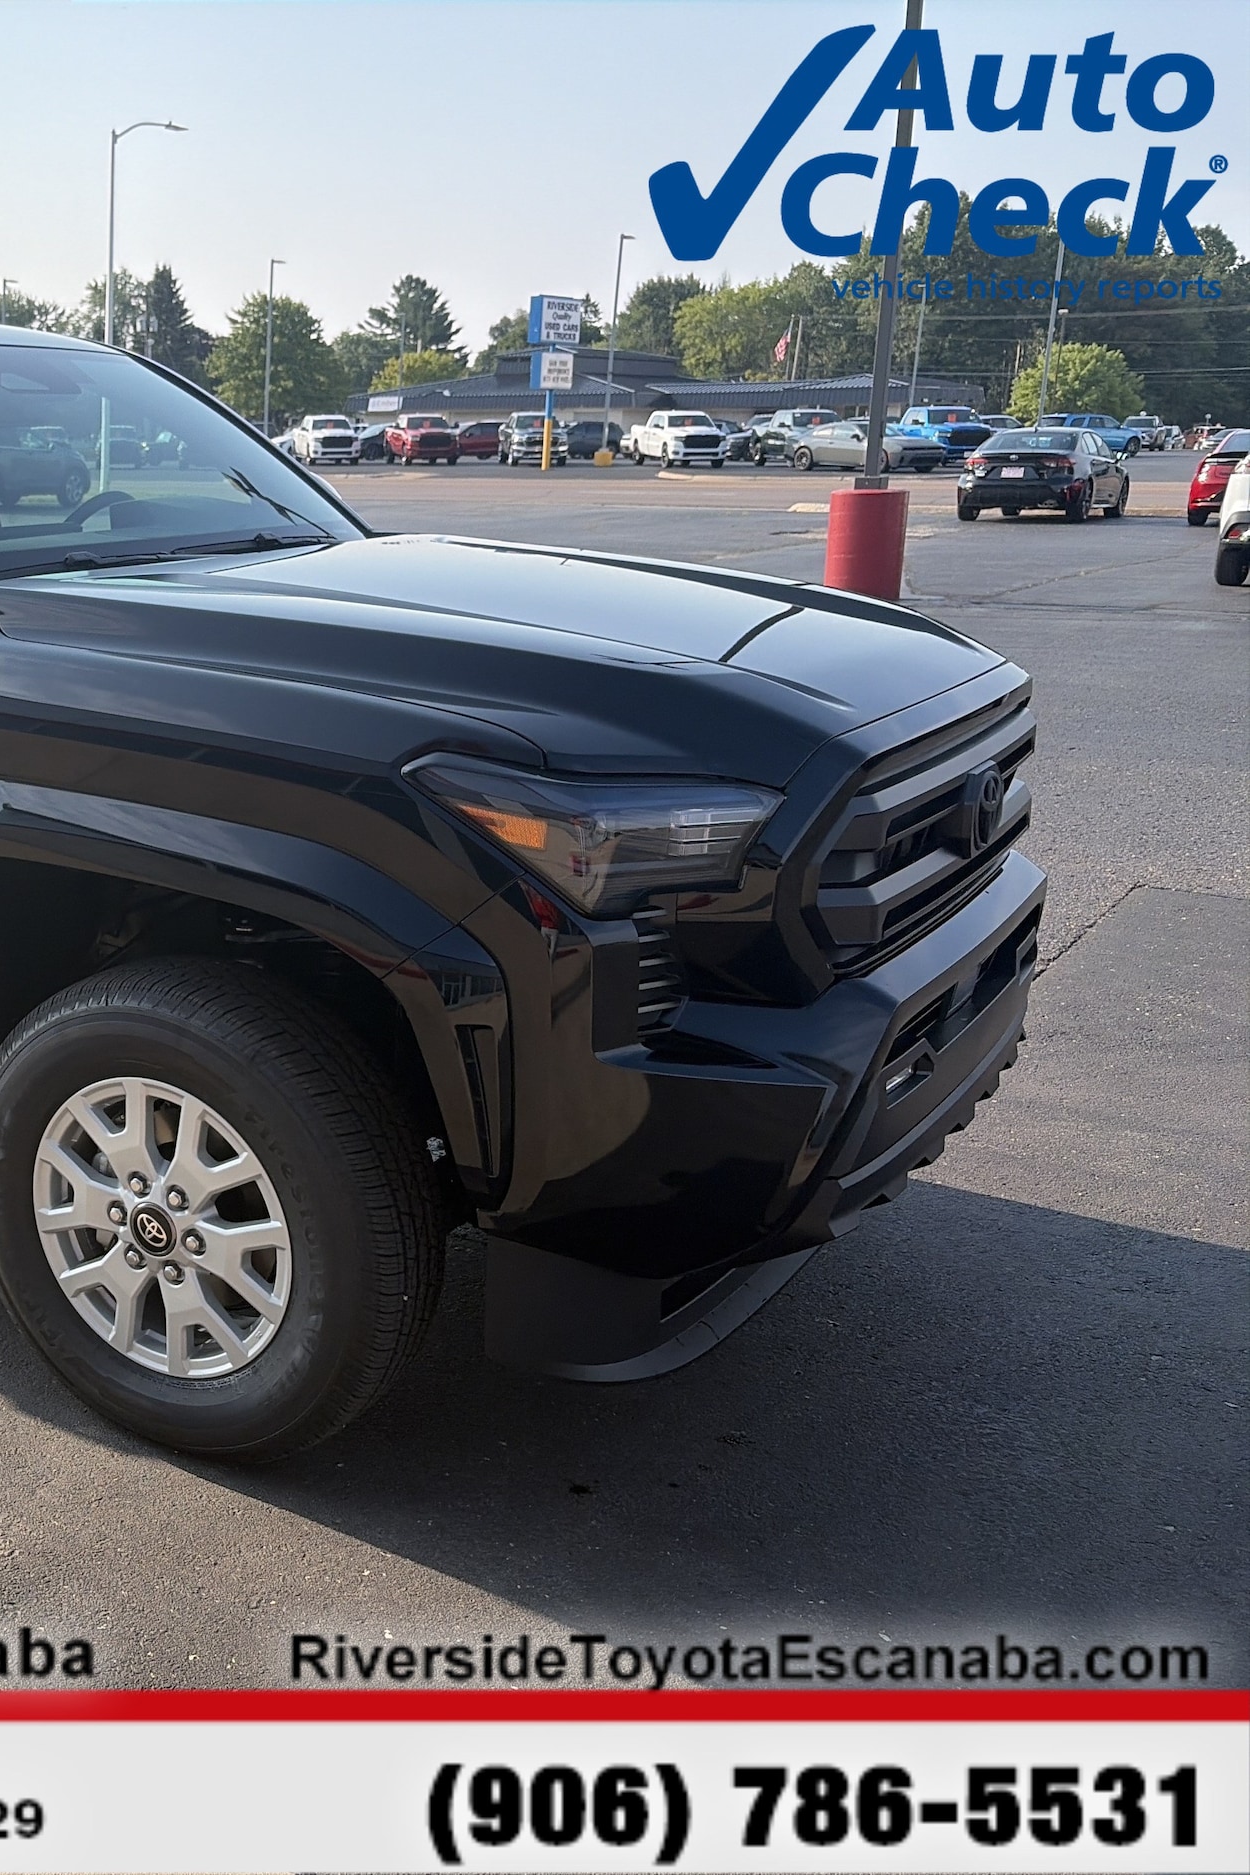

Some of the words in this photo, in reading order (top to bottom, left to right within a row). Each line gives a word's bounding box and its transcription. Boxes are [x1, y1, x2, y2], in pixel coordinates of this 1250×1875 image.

[547, 301, 579, 312] RIVERSIDE
[552, 312, 572, 321] Quality
[545, 322, 560, 331] USED
[562, 323, 579, 332] CARS
[553, 332, 577, 340] TRUCKS
